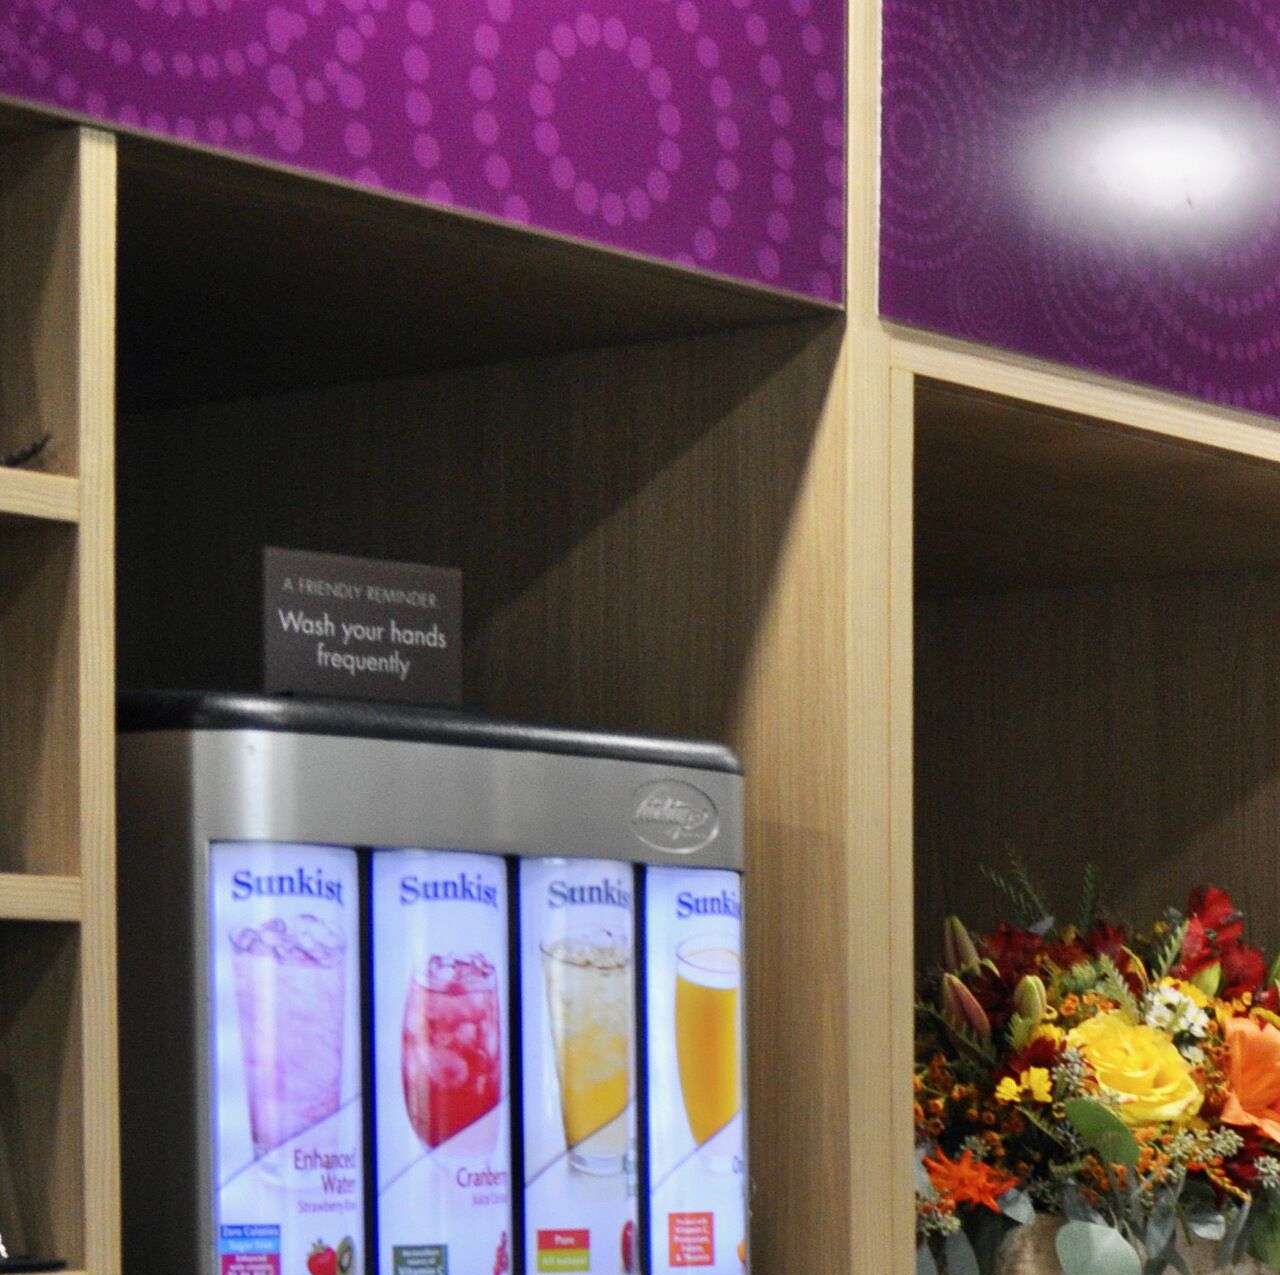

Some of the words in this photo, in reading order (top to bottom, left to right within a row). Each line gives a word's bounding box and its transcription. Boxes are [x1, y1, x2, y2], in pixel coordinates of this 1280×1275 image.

[282, 576, 294, 591] A
[300, 577, 361, 600] FRIENDLY
[278, 608, 335, 637] Wash
[341, 621, 385, 645] your
[391, 619, 447, 649] hands
[317, 642, 411, 682] frequently
[232, 867, 344, 908] Sunkist
[400, 872, 498, 909] Sunkist
[293, 1147, 356, 1171] Enhanced
